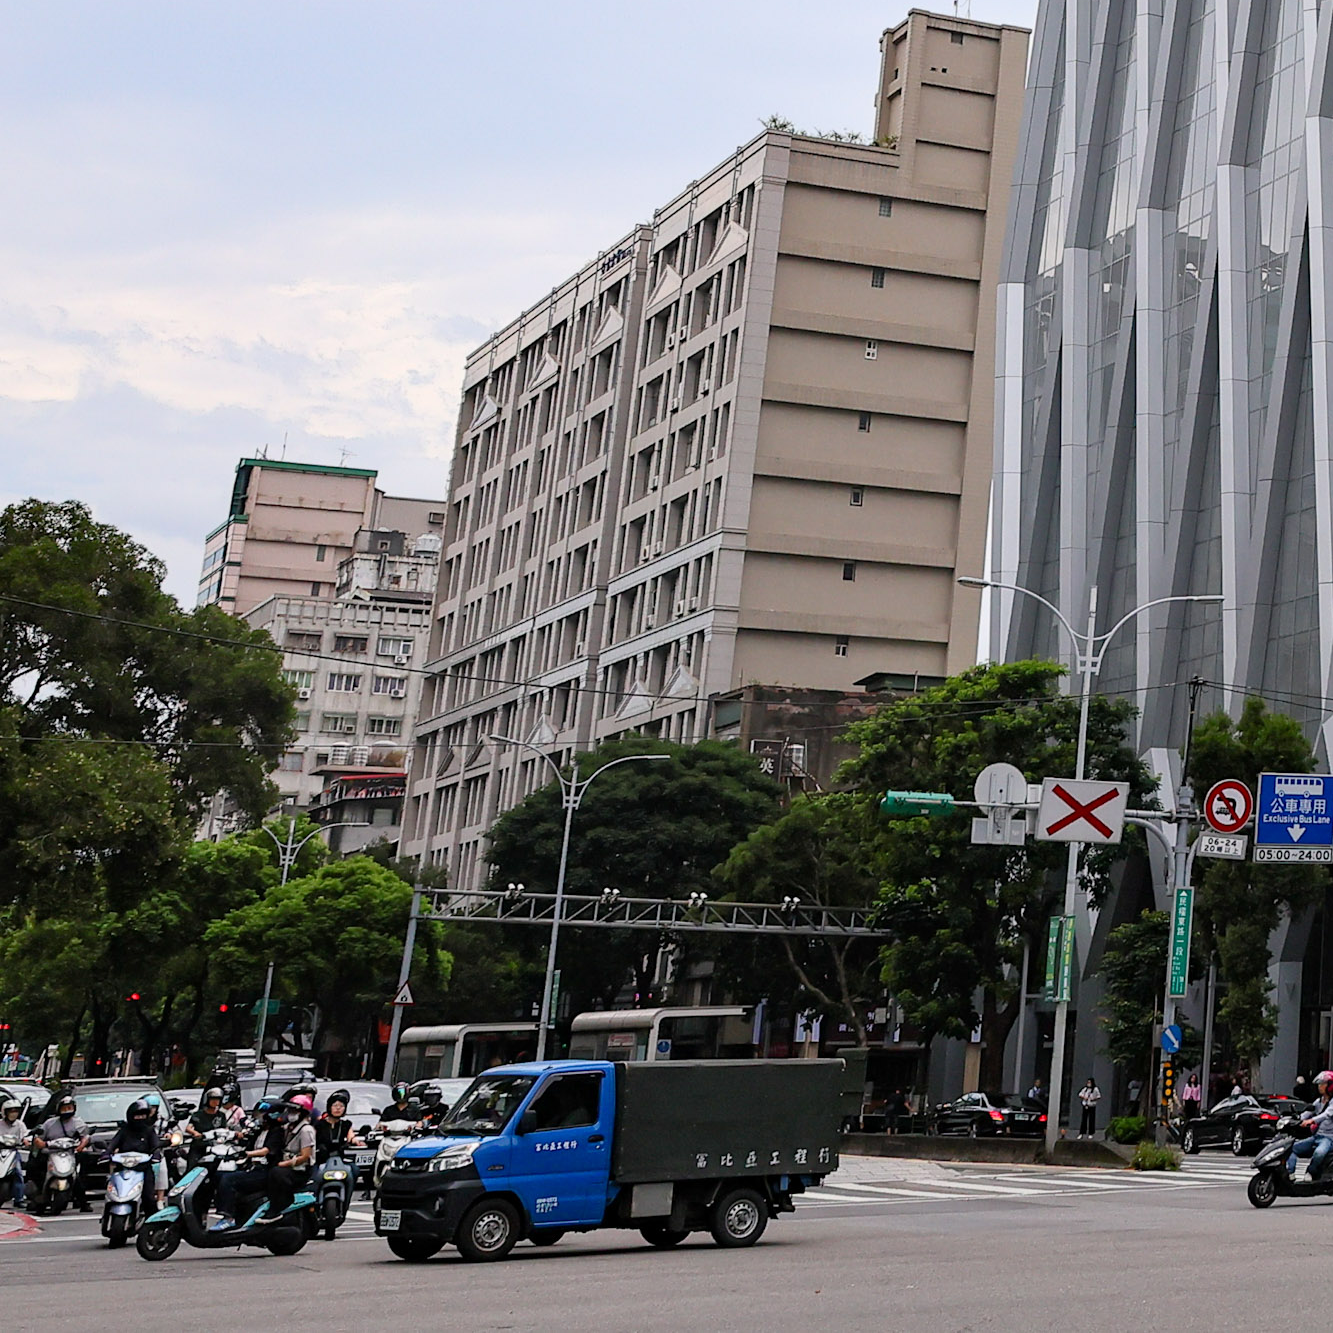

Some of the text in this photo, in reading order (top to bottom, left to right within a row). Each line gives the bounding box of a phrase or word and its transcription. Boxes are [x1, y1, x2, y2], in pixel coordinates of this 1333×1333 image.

[1270, 798, 1326, 815] 公車專用
[1263, 813, 1330, 825] Exclusive Bus Lane
[1208, 837, 1237, 847] 06-24
